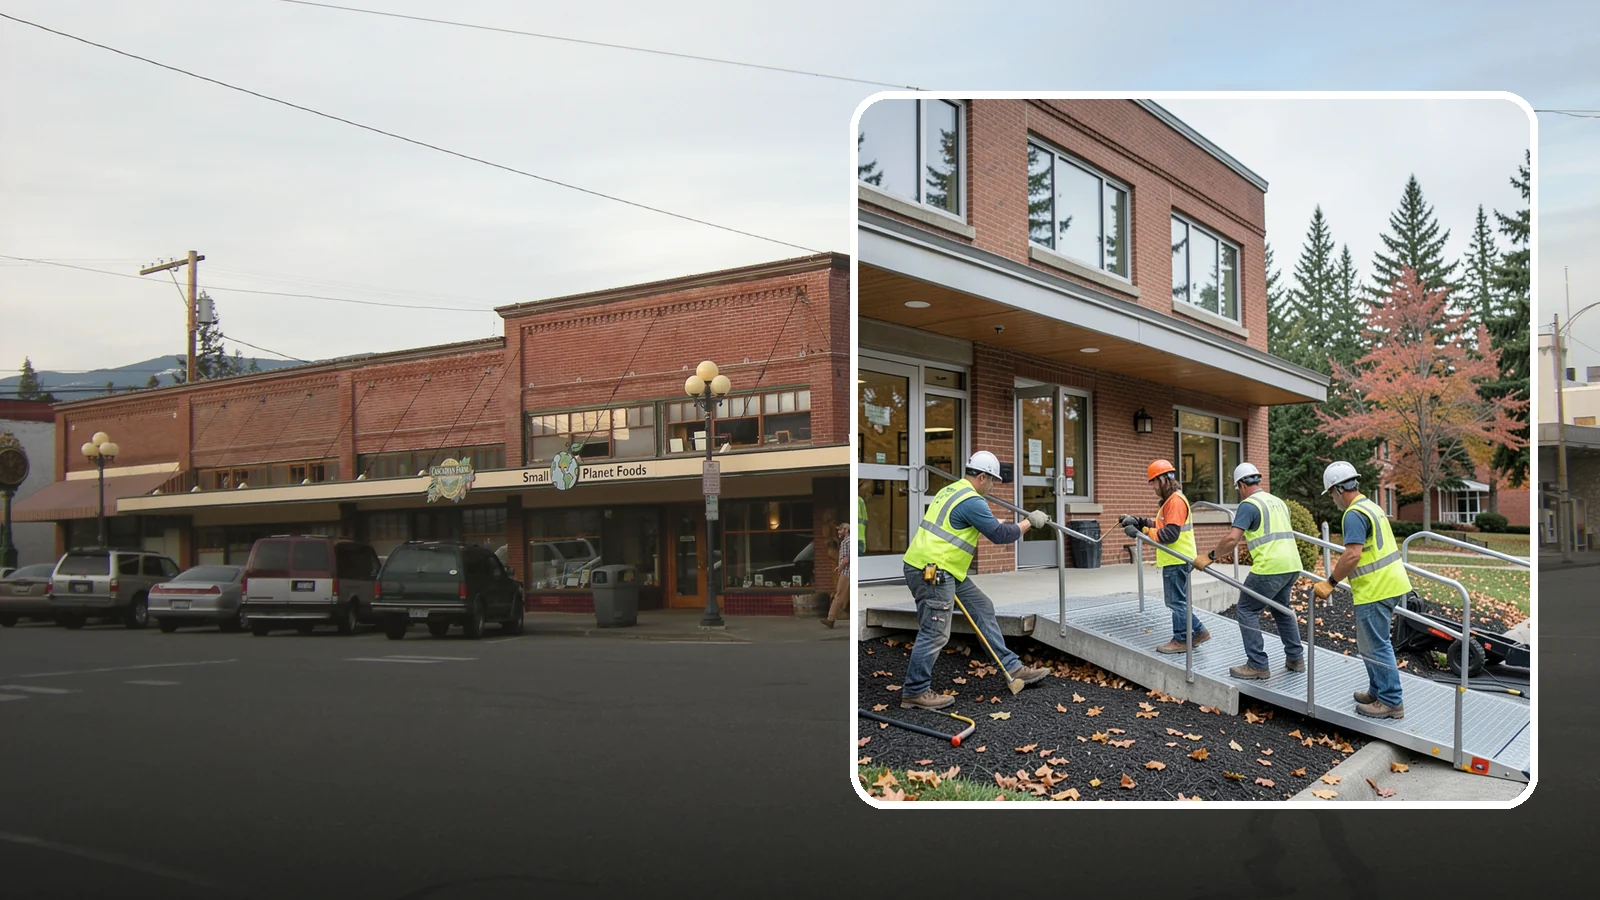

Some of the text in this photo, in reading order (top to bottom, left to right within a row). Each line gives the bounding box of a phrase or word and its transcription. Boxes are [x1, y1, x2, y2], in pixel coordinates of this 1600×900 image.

[523, 464, 647, 483] Small Planet Foods
